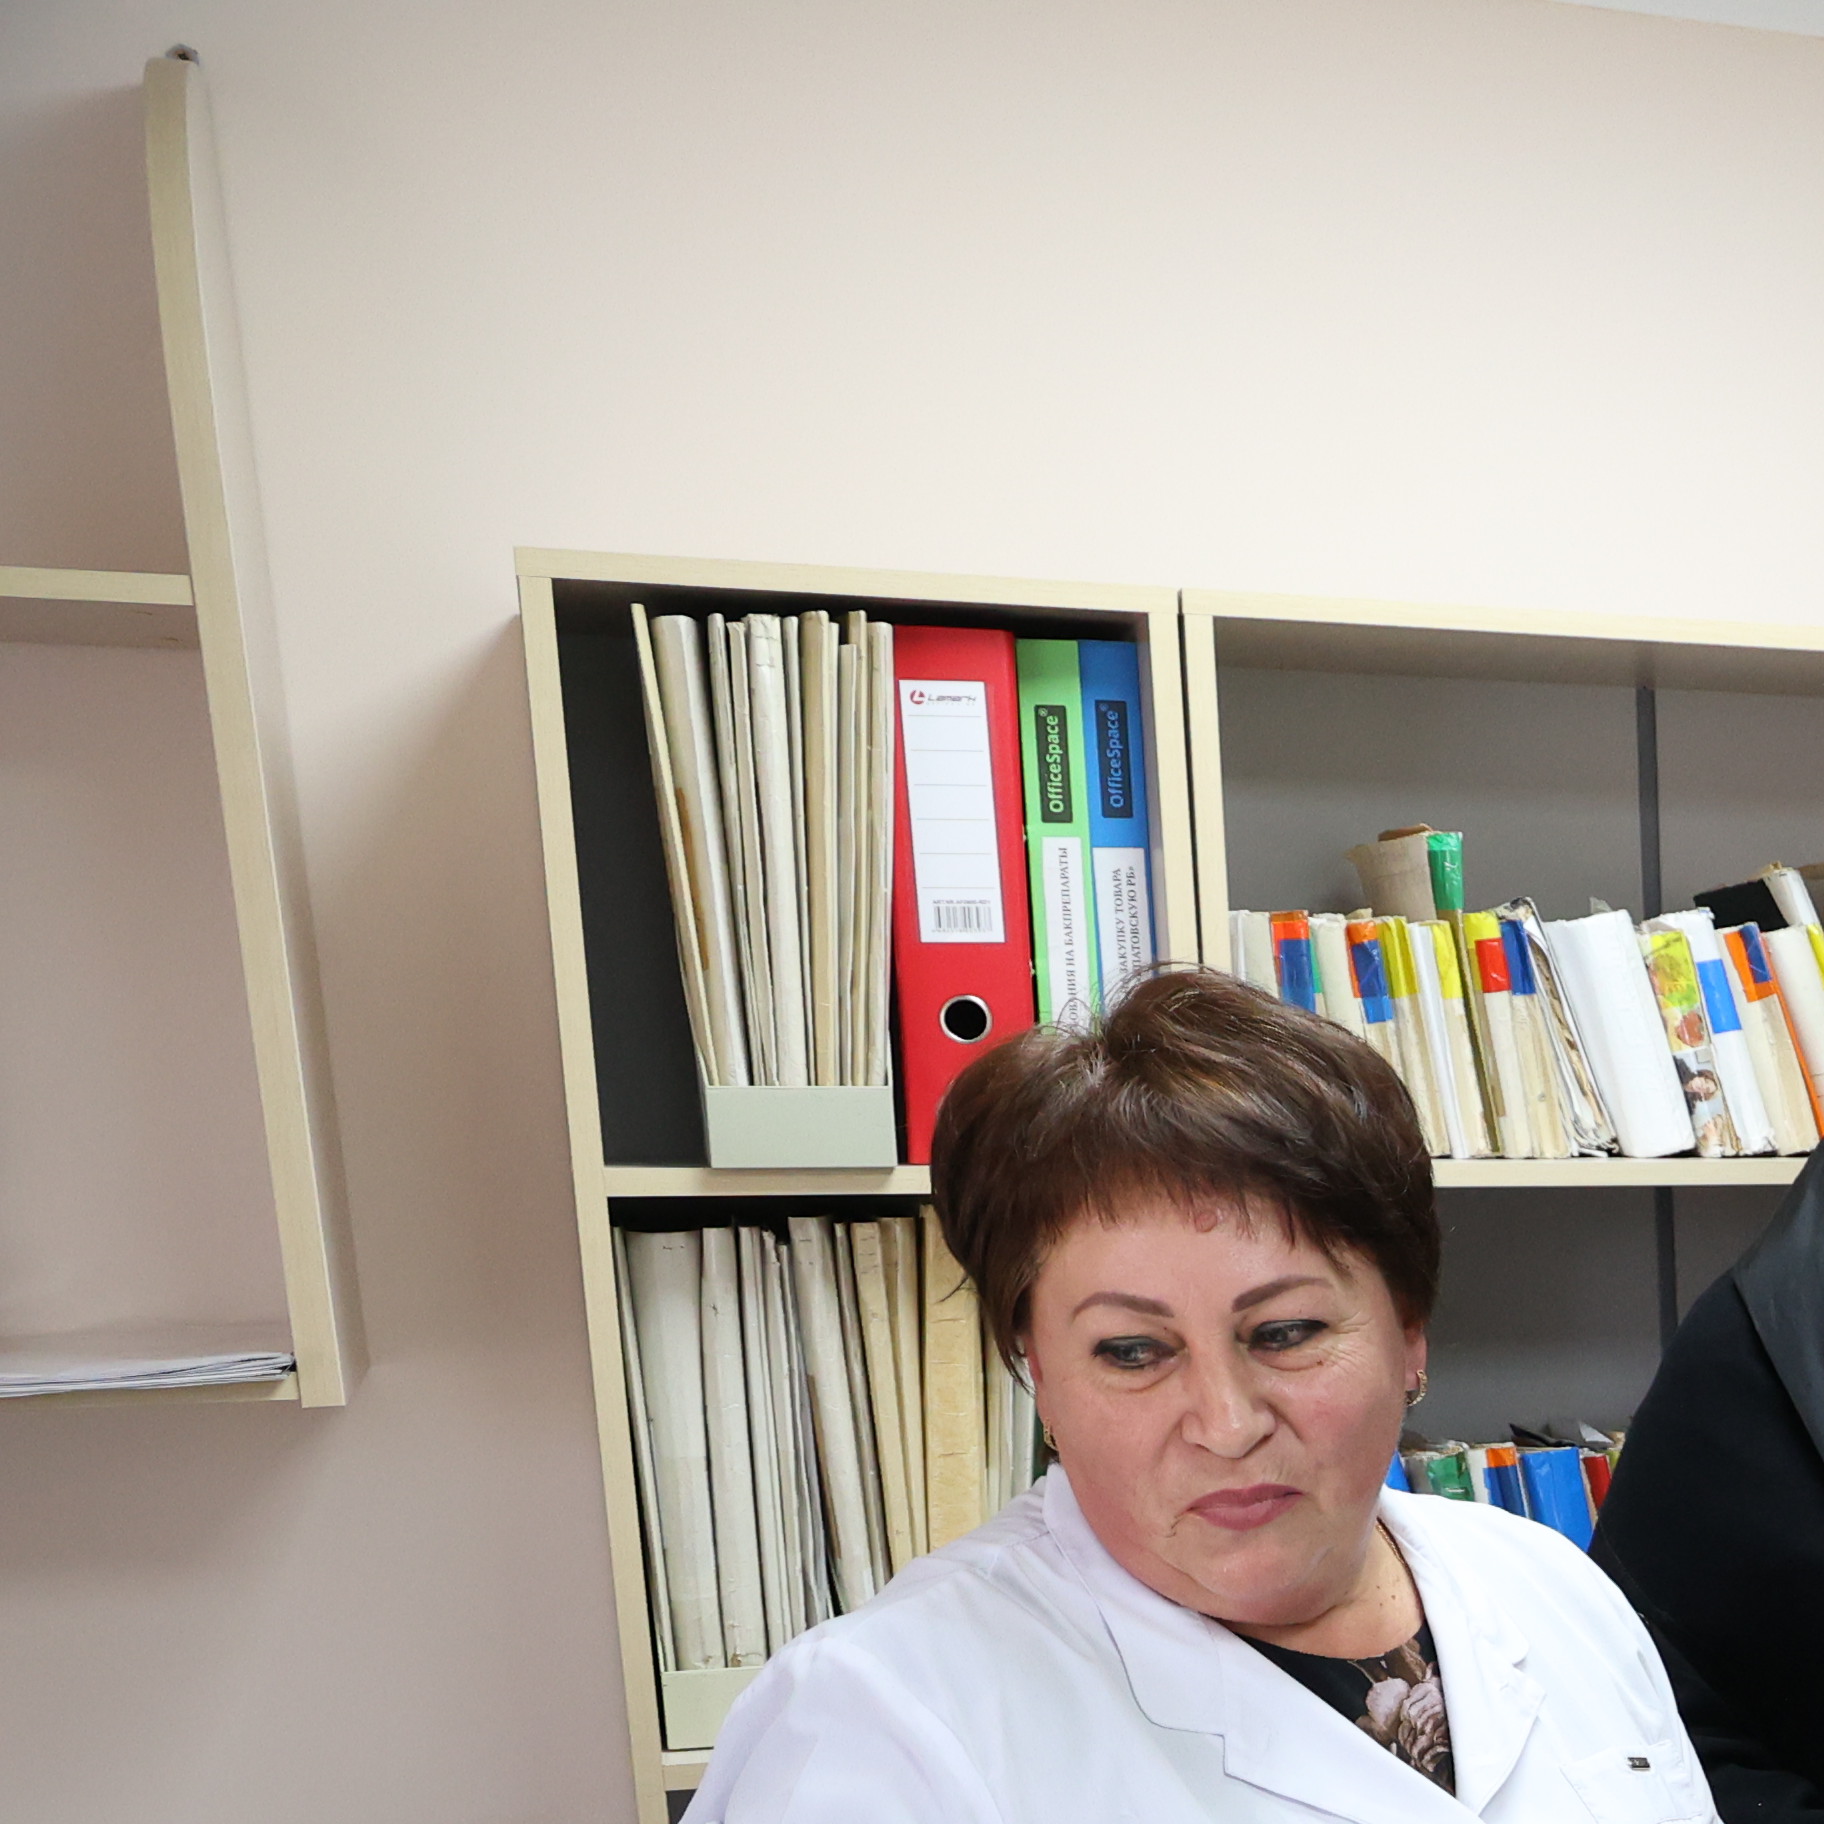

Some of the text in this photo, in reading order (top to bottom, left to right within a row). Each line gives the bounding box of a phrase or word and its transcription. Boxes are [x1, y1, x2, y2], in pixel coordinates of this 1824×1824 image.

[1058, 847, 1074, 947] БАКПРЕПАРАТЫ
[1112, 868, 1126, 915] ТОВАРА
[1064, 951, 1077, 968] НА
[1114, 917, 1129, 975] ЗАКУПКУ
